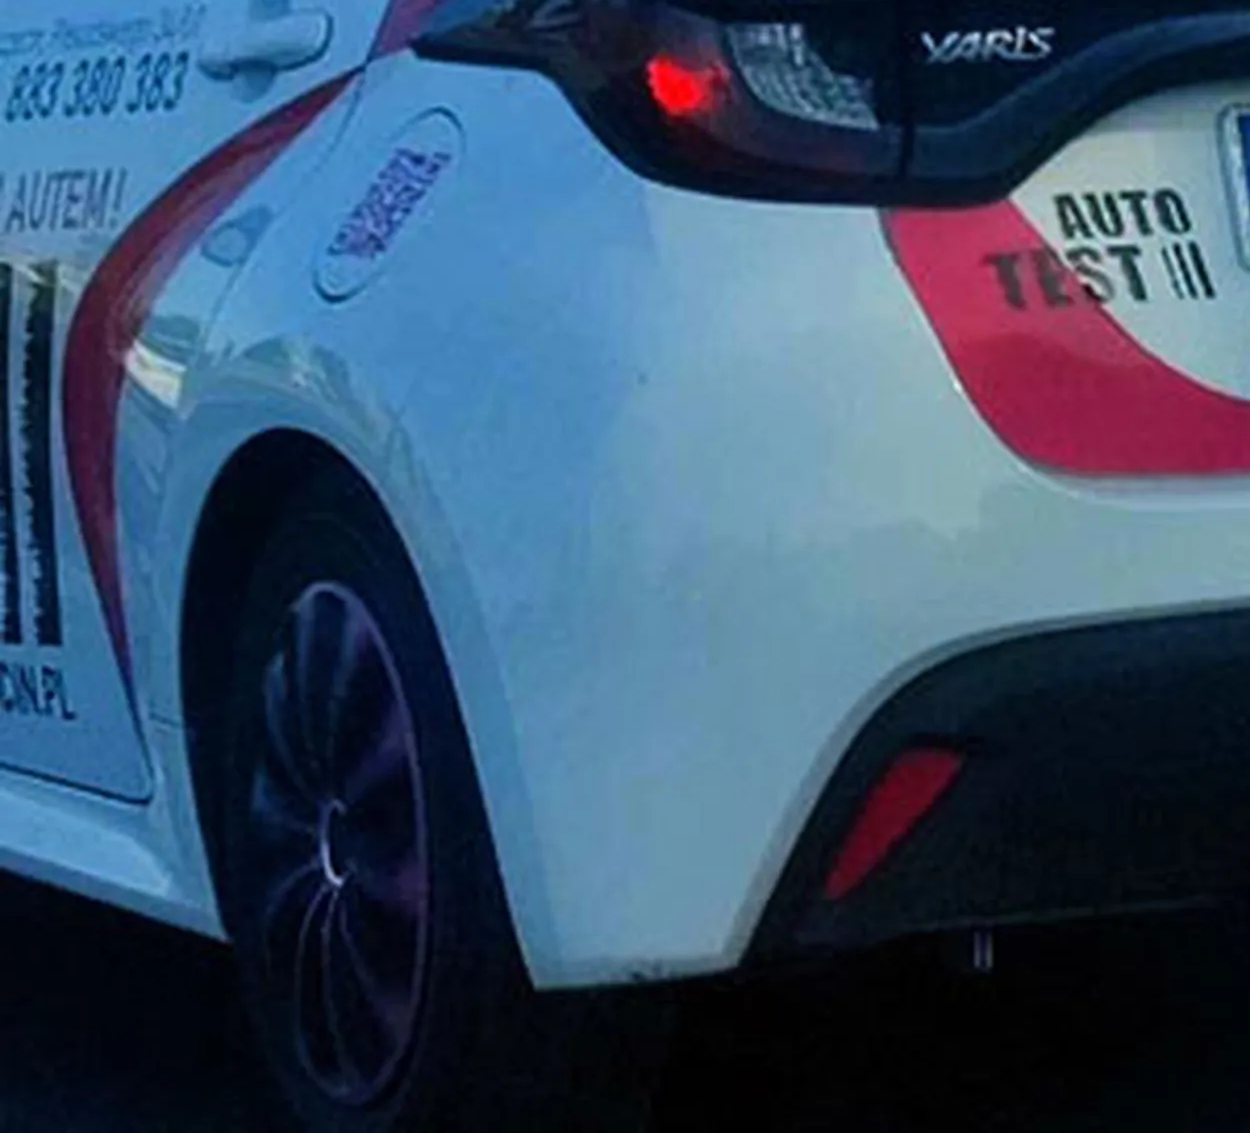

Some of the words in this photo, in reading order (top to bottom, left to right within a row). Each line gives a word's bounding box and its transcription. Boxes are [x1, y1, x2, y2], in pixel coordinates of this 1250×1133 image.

[921, 25, 1056, 65] YARIS
[1053, 188, 1191, 240] AUTO
[984, 244, 1148, 311] TEST
